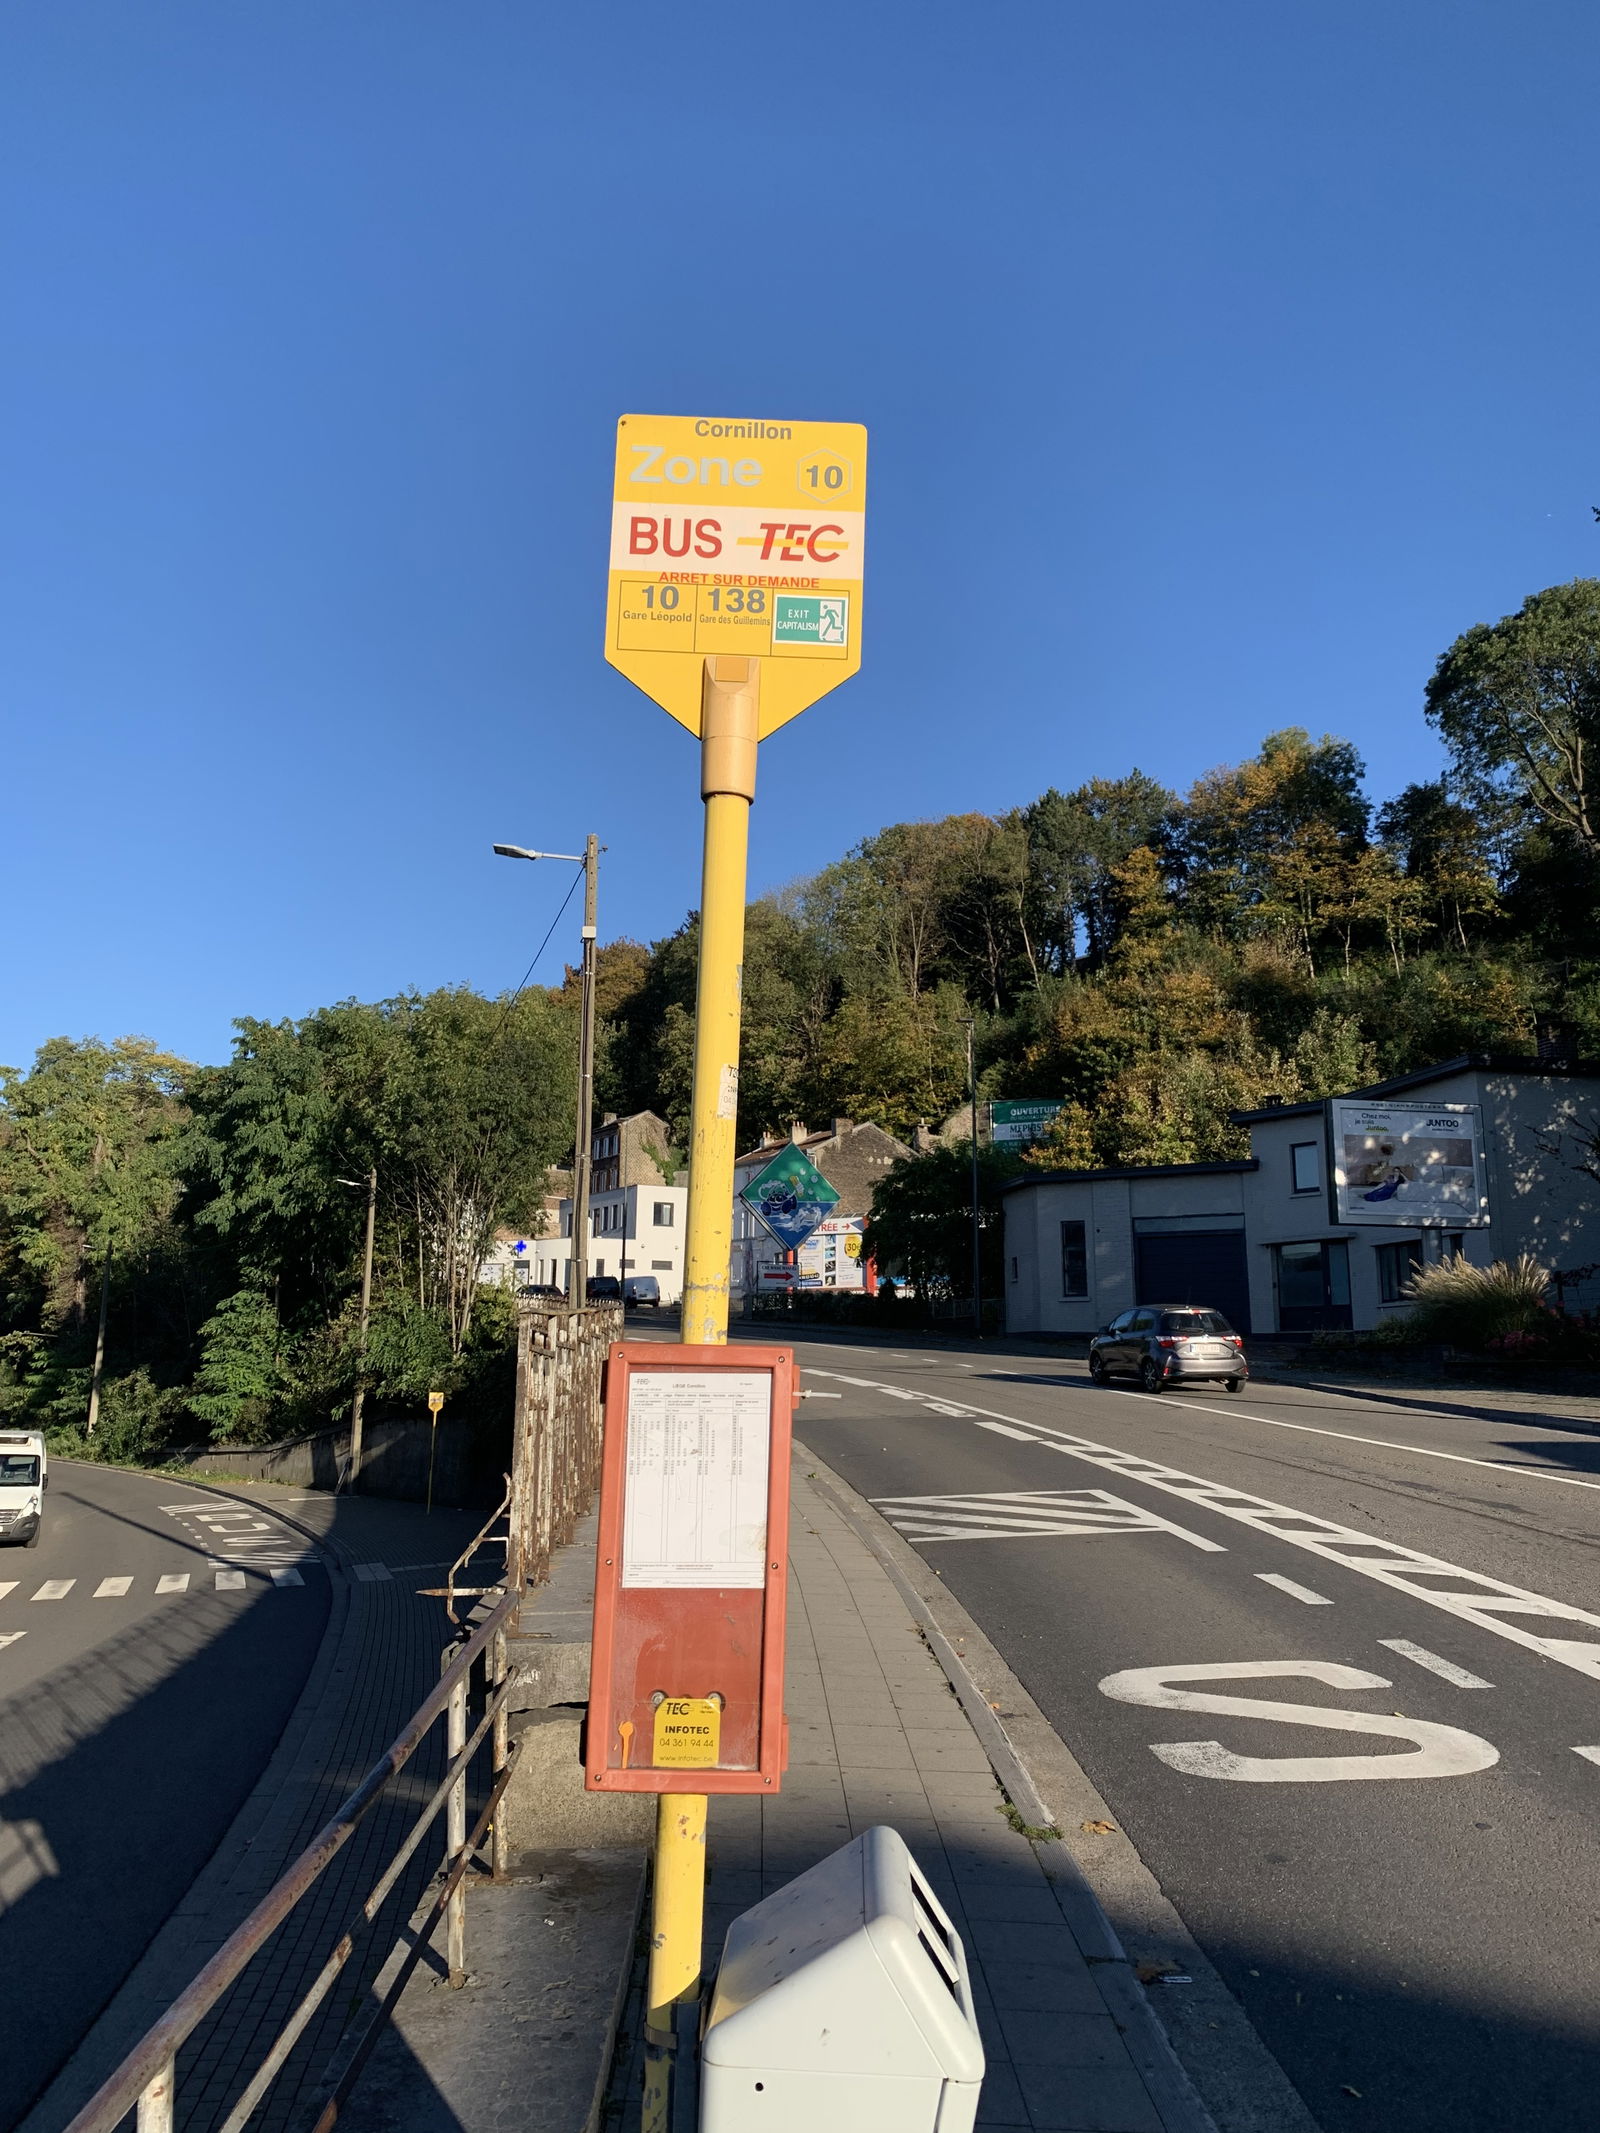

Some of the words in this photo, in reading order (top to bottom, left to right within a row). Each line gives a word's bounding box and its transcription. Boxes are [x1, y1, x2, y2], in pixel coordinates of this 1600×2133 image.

[695, 419, 793, 441] Cornillon
[630, 446, 763, 487] Zone
[806, 465, 844, 489] 10
[629, 516, 722, 559] BUS
[759, 522, 845, 563] TEC
[658, 571, 708, 585] ARRET
[713, 573, 745, 586] SUR
[748, 575, 820, 589] DEMANDE
[641, 585, 680, 611] 10
[707, 588, 766, 614] 138
[622, 610, 648, 621] Gare
[650, 609, 692, 623] Léopold
[699, 614, 717, 625] Gare
[718, 614, 732, 625] des
[733, 614, 771, 627] Guillemins
[787, 608, 810, 619] EXIT
[777, 620, 819, 632] CAPITALISM
[1426, 1119, 1459, 1127] JUNTOO
[666, 1702, 690, 1715] TEC
[665, 1725, 710, 1735] INFOTEC
[659, 1738, 670, 1747] 04
[672, 1738, 687, 1747] 361
[690, 1738, 701, 1747] 94
[703, 1739, 714, 1748] 44
